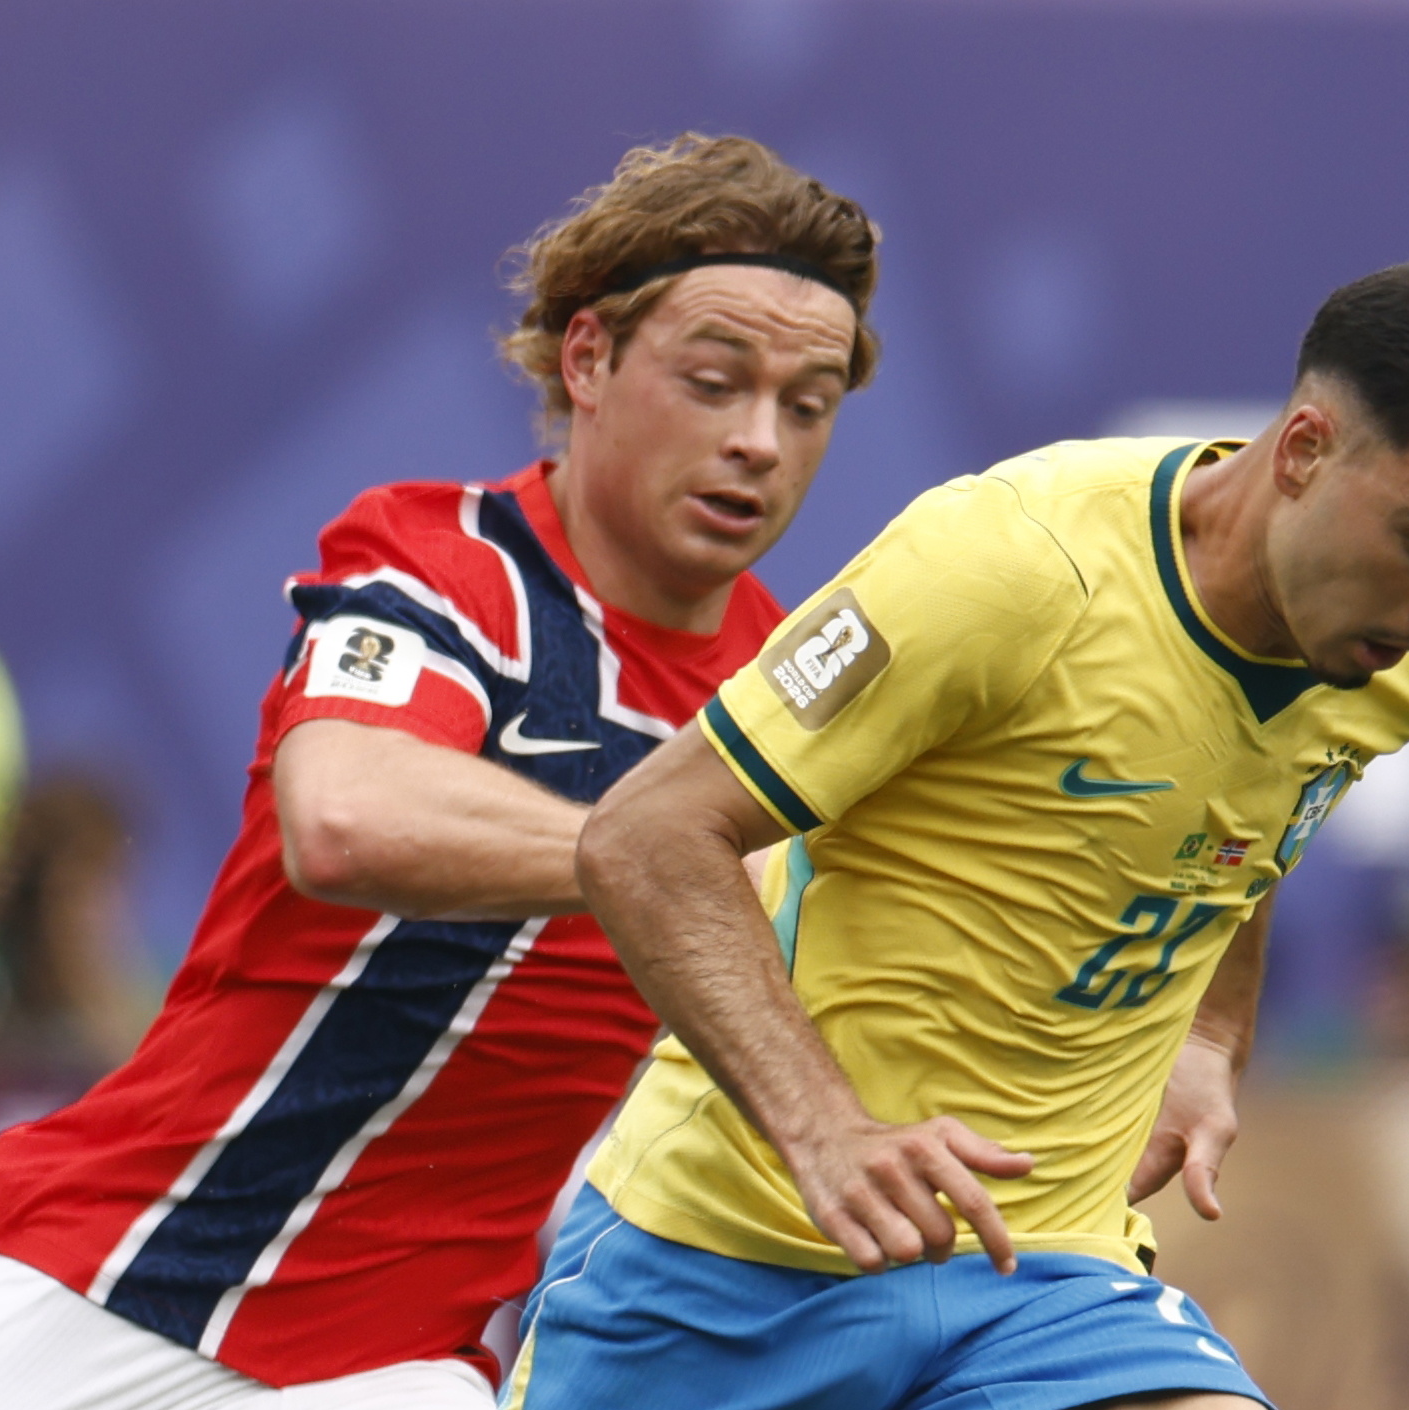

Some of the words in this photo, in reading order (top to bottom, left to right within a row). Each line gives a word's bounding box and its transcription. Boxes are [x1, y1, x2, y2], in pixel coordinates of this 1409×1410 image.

[772, 665, 810, 709] 2026
[782, 658, 805, 686] WORLD
[801, 684, 817, 700] CUP
[804, 658, 822, 680] FIFA
